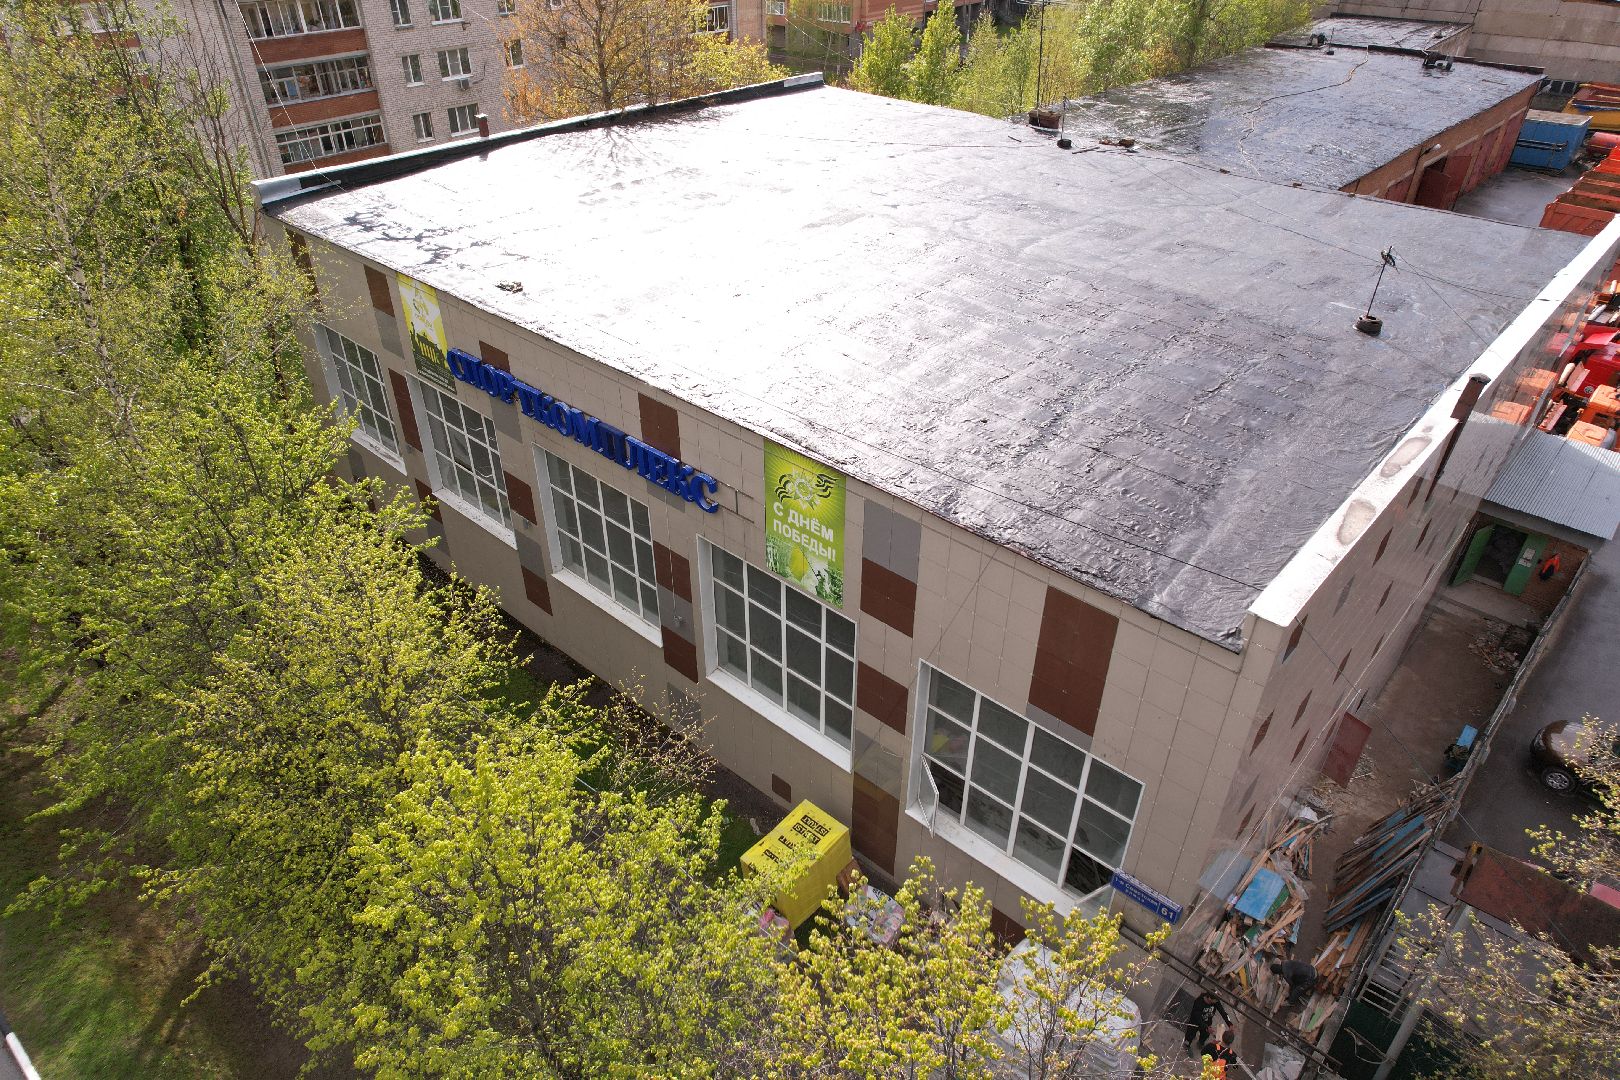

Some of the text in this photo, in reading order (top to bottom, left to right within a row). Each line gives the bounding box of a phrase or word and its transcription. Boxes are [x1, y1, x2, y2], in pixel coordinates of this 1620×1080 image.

[447, 348, 719, 514] СПОРТКОМПЛЕКС
[773, 501, 834, 543] С ДНЁМ
[773, 518, 836, 562] ПОБЕДЫ!
[1161, 907, 1174, 919] 61
